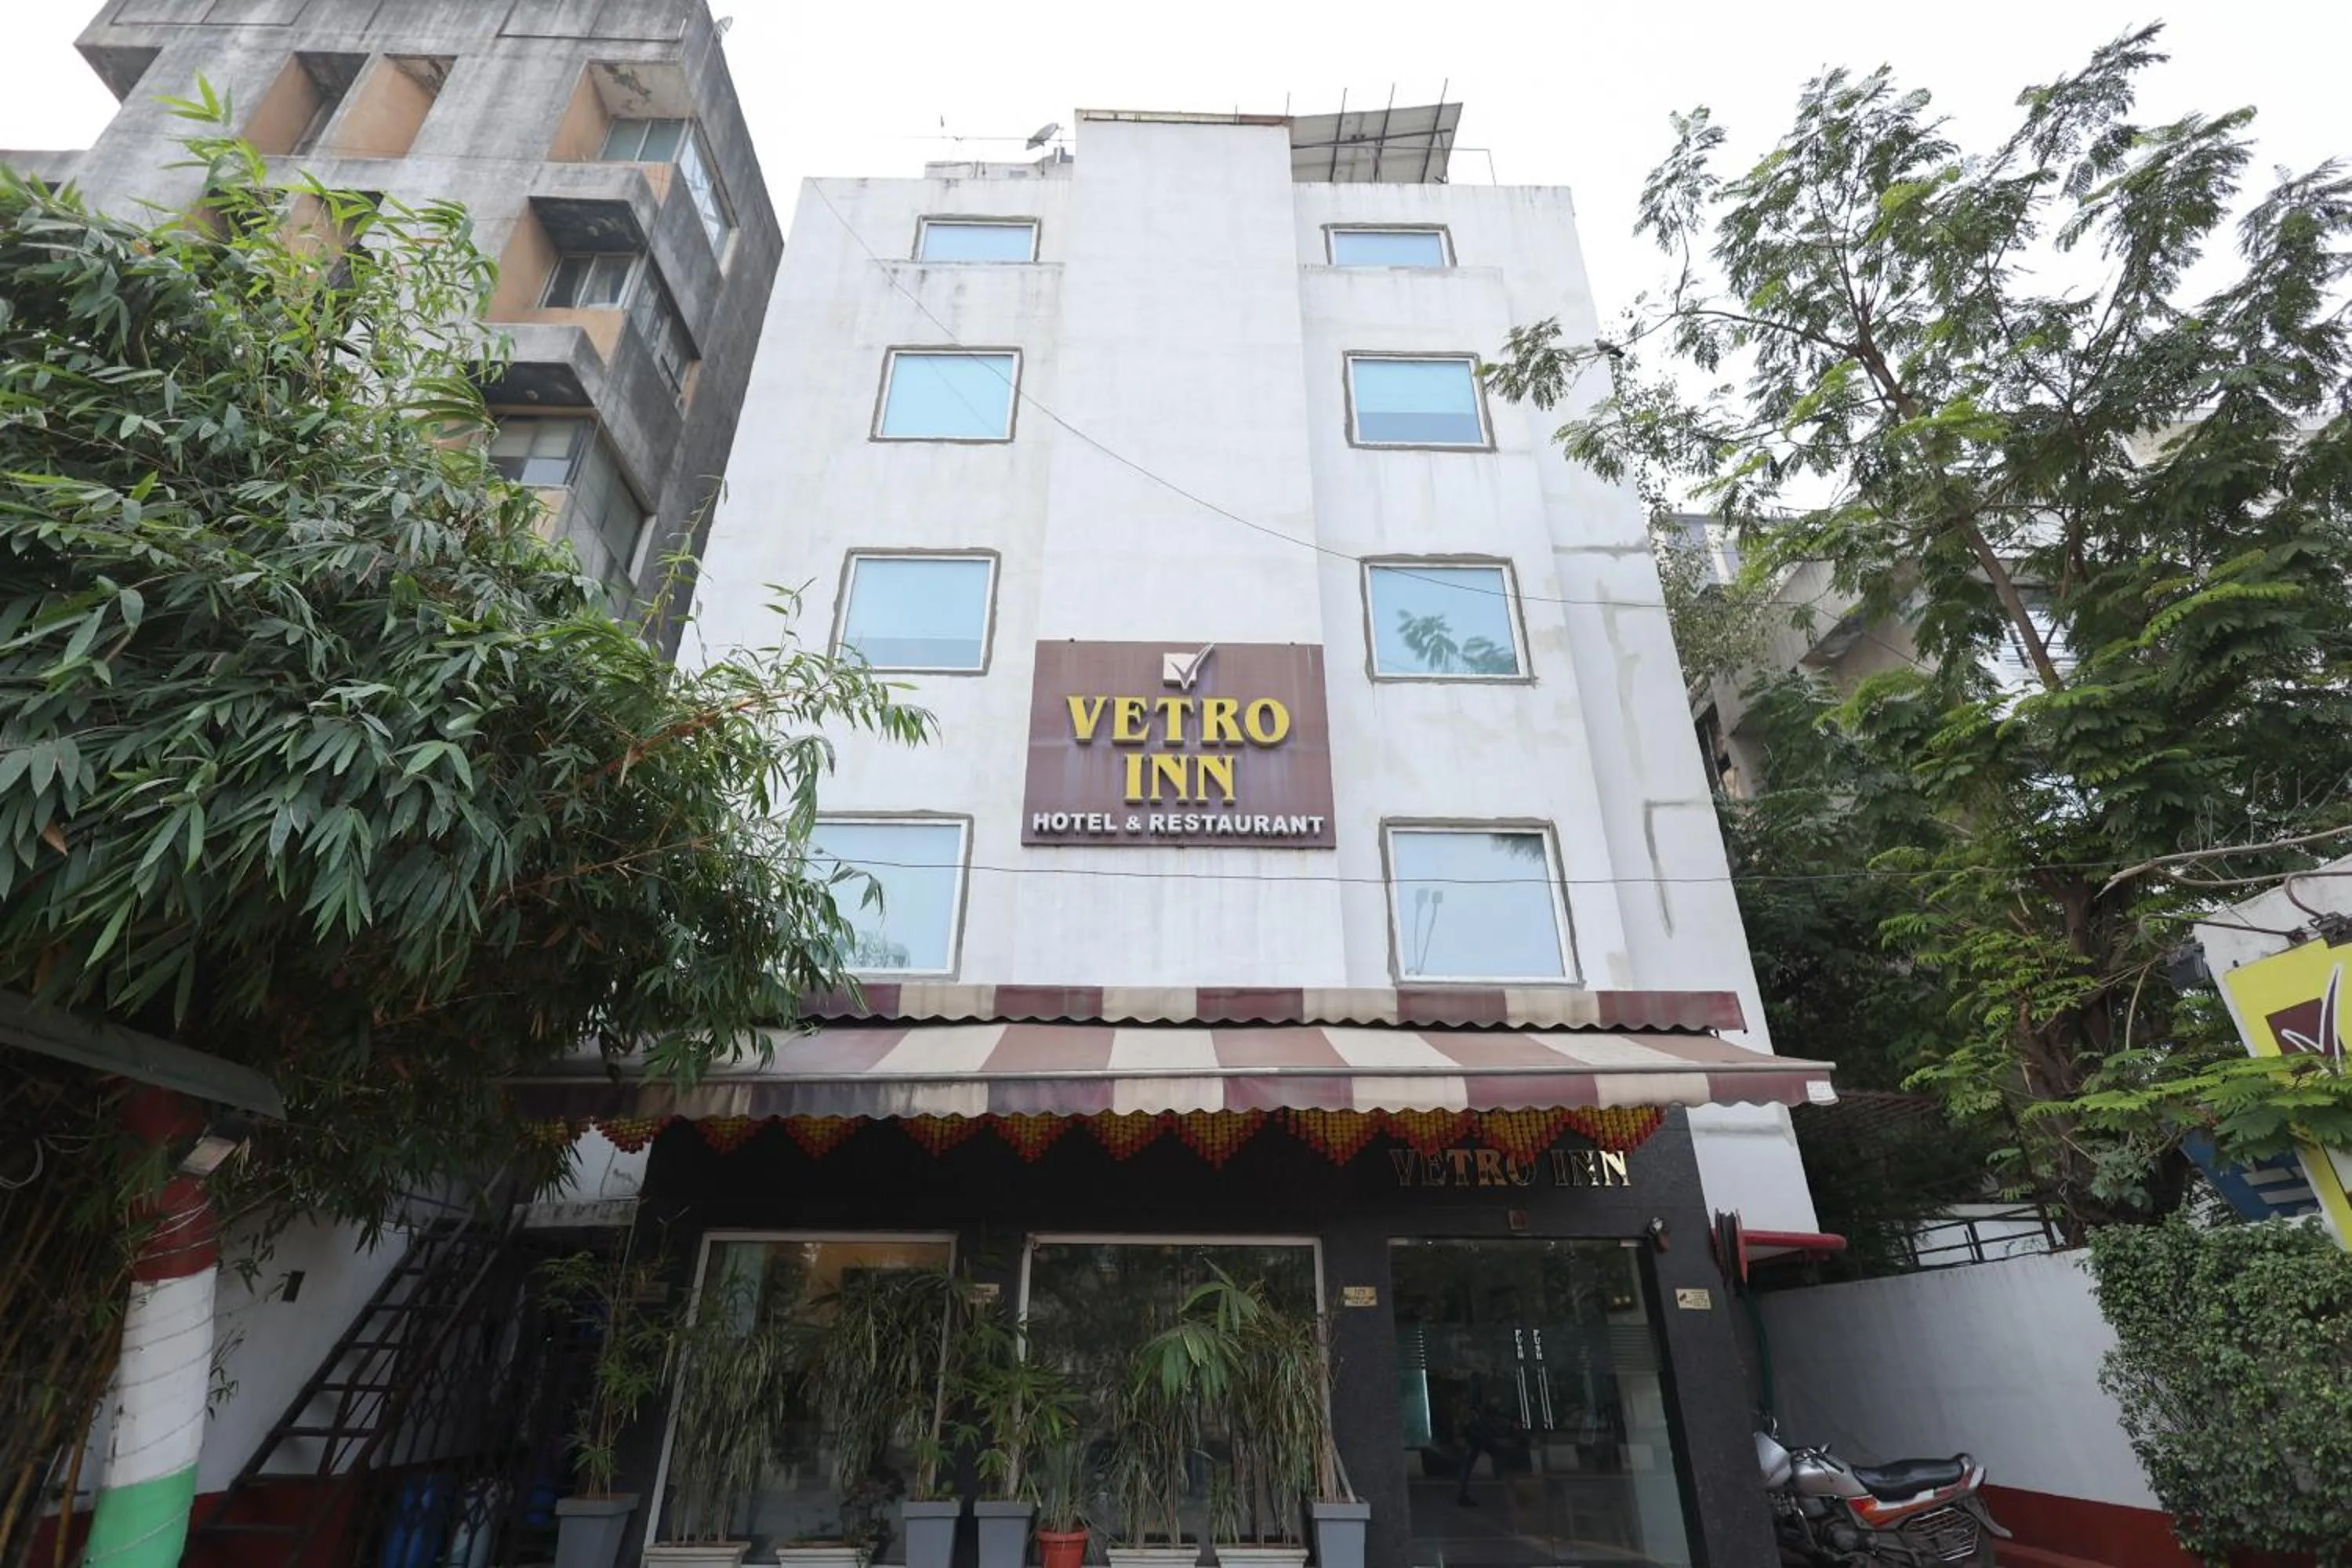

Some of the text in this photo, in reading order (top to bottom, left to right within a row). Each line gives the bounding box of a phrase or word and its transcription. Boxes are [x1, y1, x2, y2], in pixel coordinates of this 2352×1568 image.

[1067, 695, 1290, 746] VETRO
[1124, 753, 1235, 804] INN
[1033, 812, 1324, 836] HOTEL & RESTAURANT
[1388, 1149, 1632, 1186] VETRO INN
